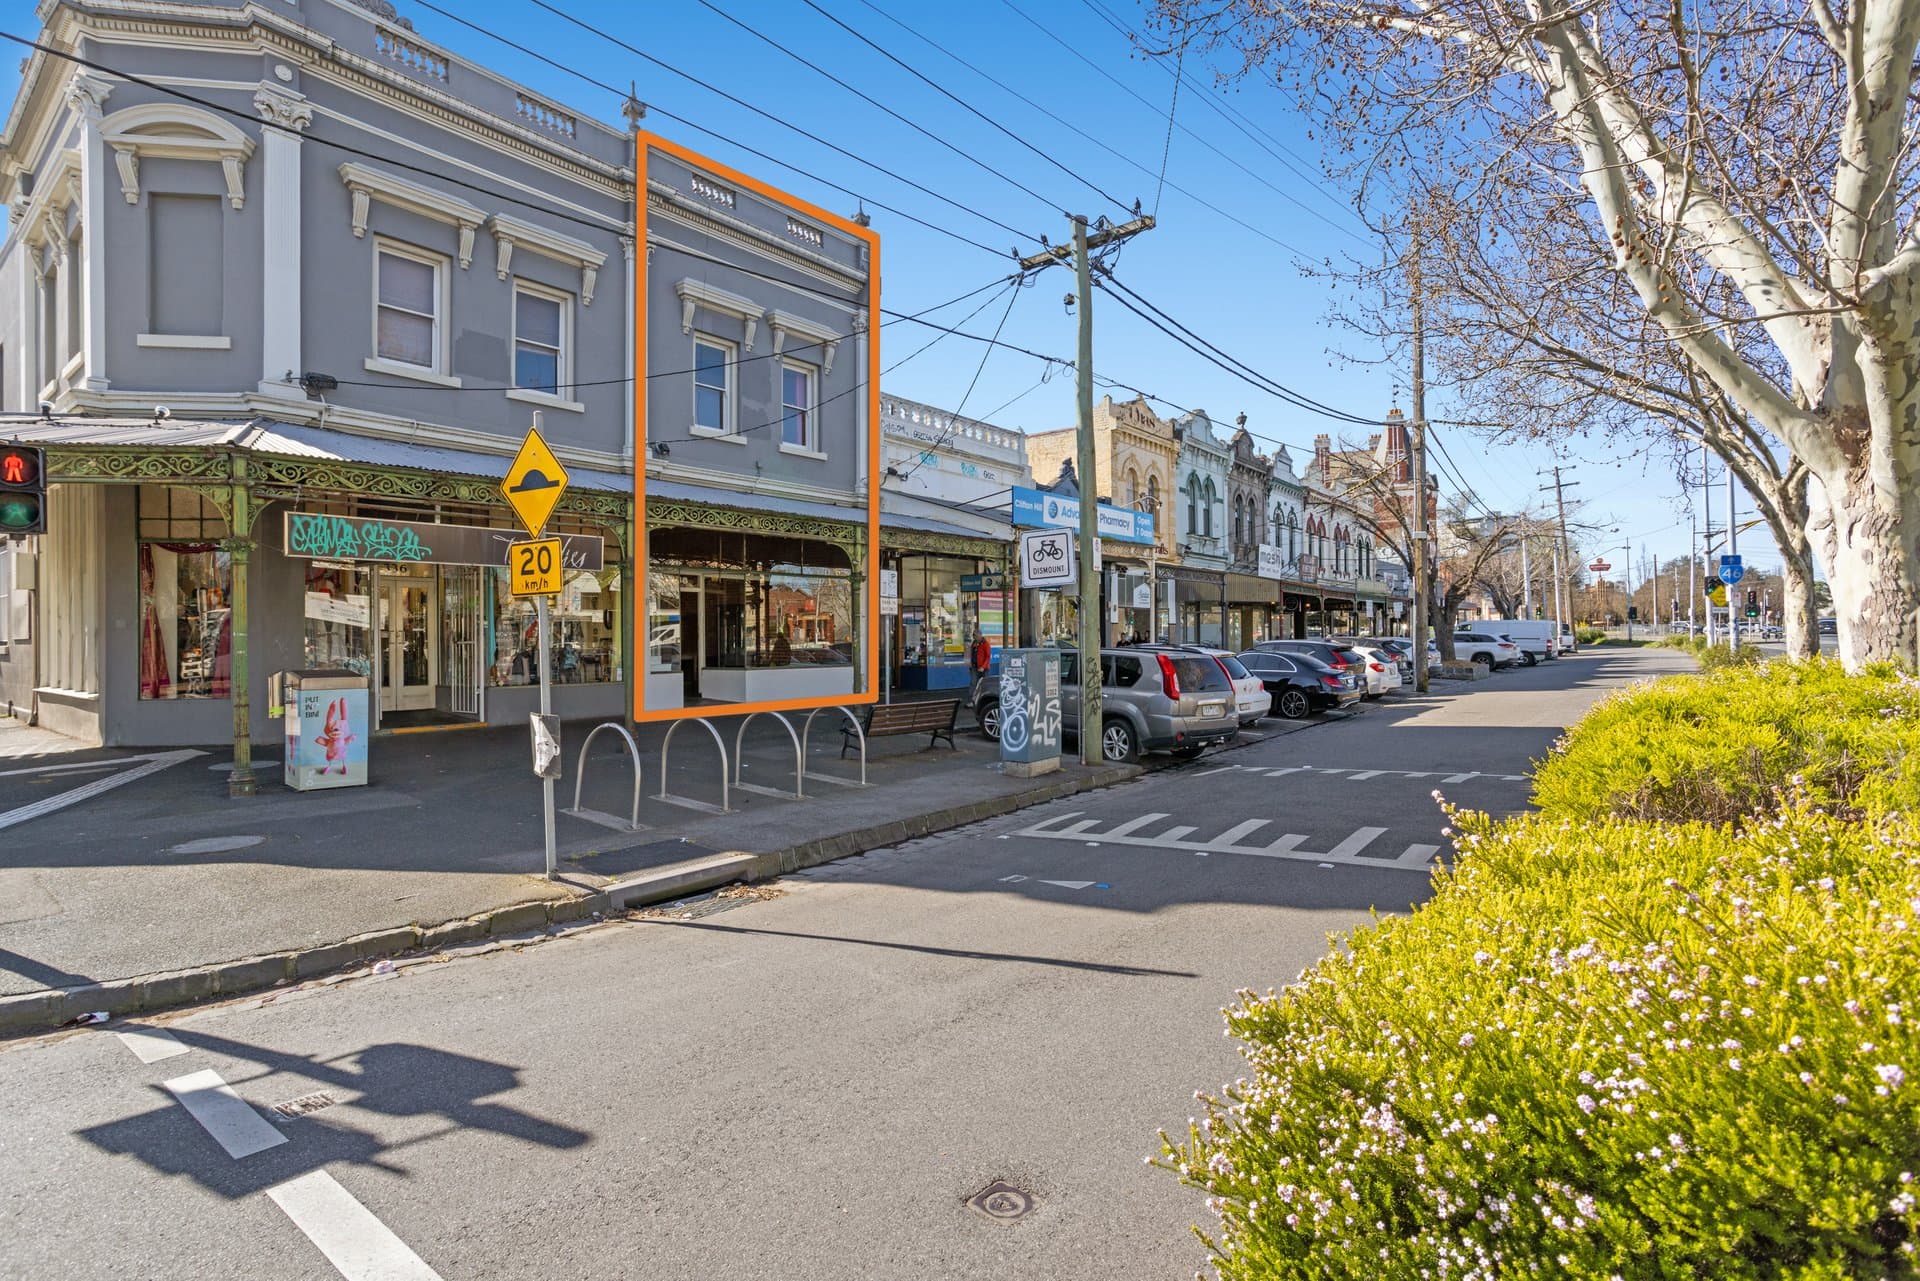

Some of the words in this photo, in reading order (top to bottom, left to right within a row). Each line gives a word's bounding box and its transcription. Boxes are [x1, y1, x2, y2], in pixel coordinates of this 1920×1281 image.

[1100, 513, 1130, 530] Pharmacy
[1137, 515, 1151, 528] Open
[521, 545, 552, 575] 20
[1033, 565, 1065, 575] DISMOUNT
[1722, 568, 1741, 578] 46
[525, 578, 549, 590] km/h
